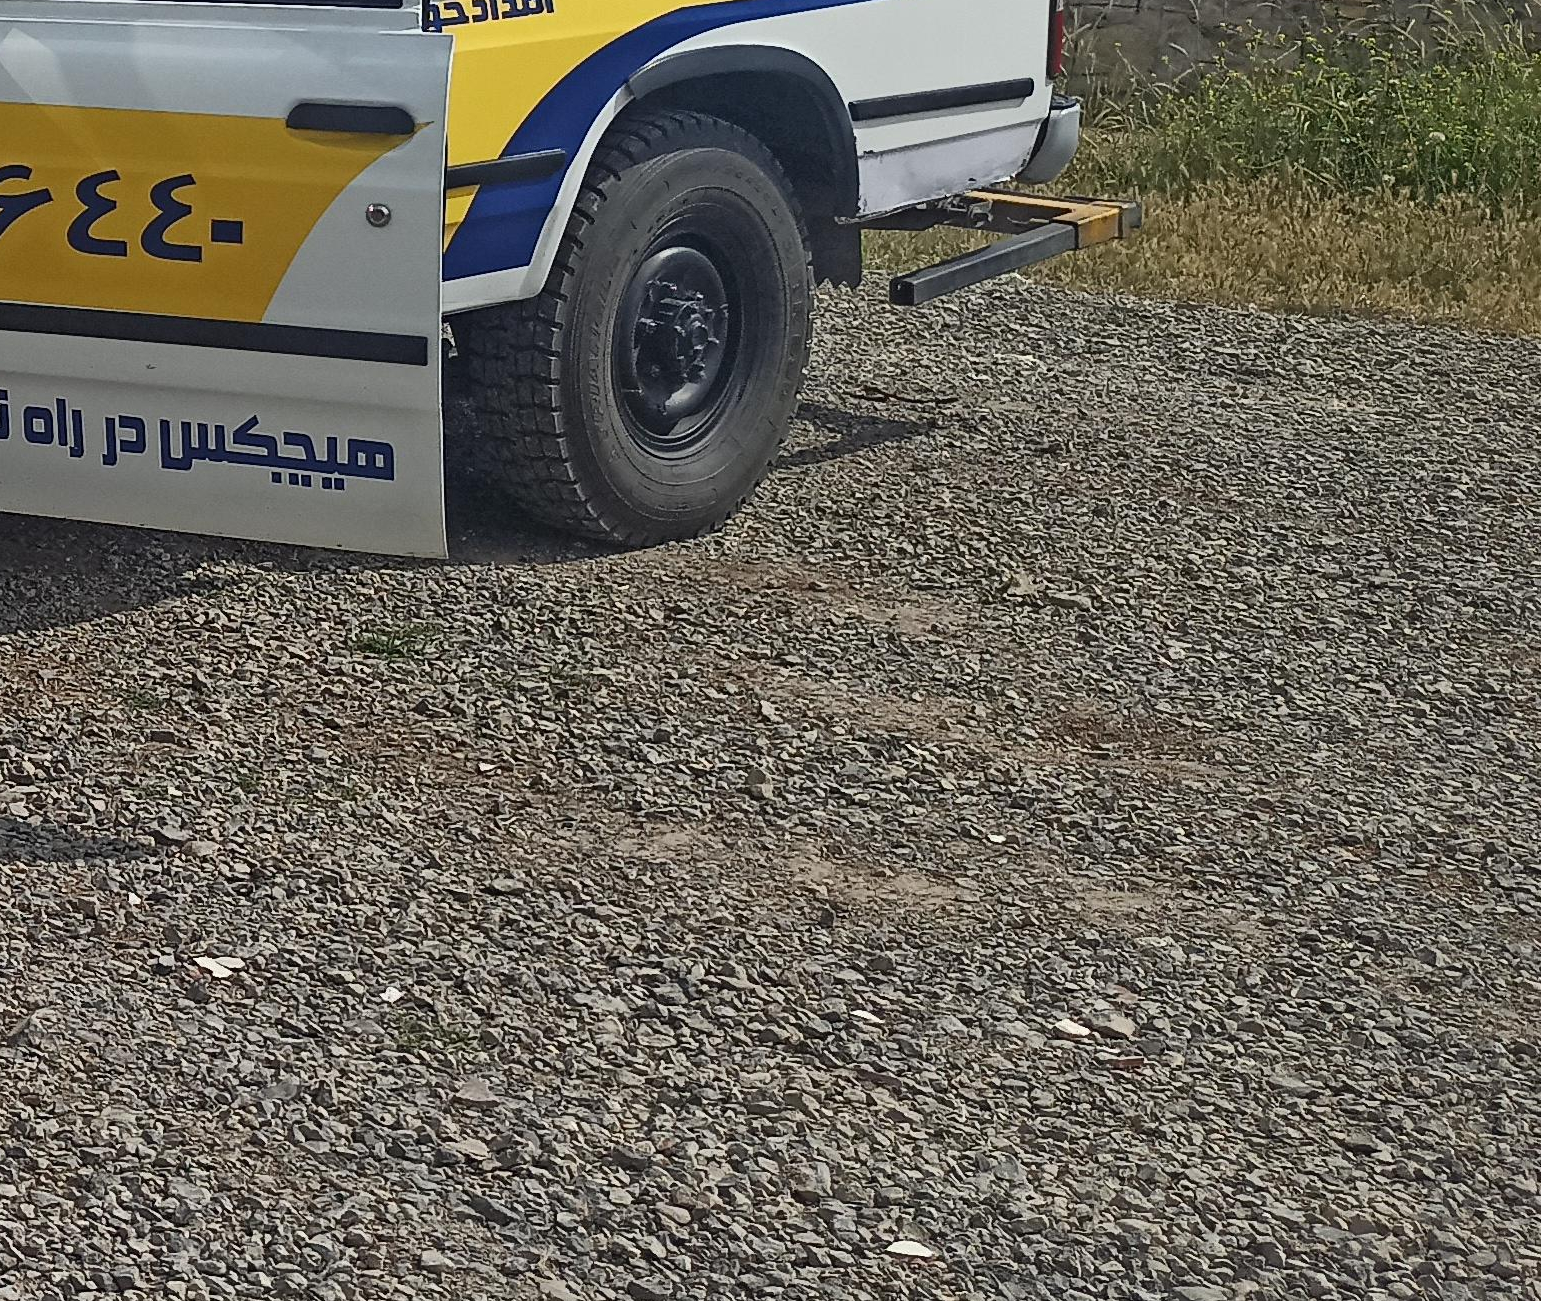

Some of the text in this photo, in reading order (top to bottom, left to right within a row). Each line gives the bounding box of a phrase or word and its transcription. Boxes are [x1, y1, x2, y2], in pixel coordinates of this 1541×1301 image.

[23, 398, 85, 458] راه
[102, 414, 146, 466] در
[159, 414, 396, 491] هیچکس
